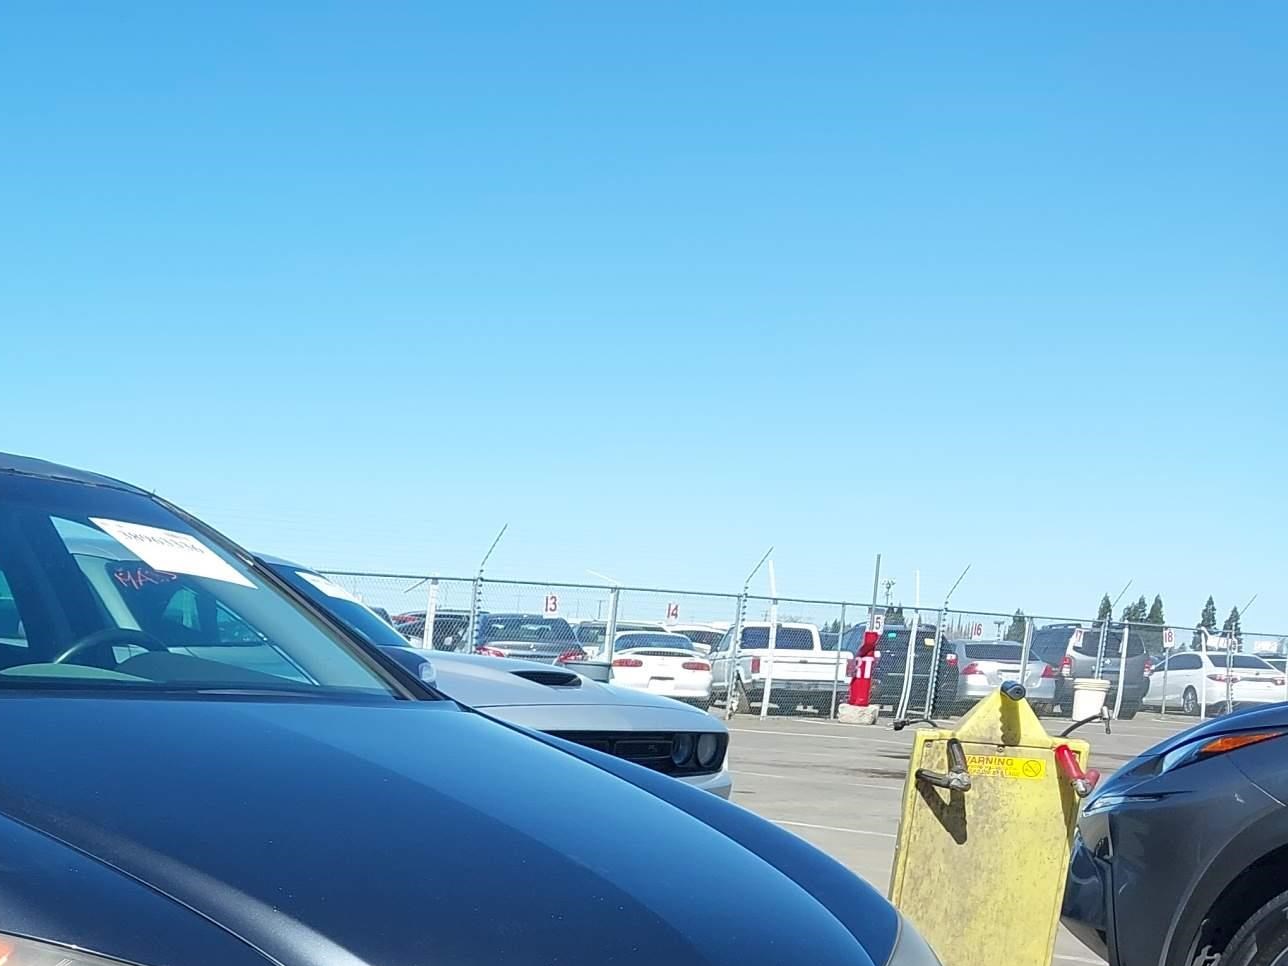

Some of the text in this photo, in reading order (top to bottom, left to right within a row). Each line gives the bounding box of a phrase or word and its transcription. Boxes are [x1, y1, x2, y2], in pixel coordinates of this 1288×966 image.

[544, 595, 558, 612] 13
[666, 603, 679, 619] 14
[973, 623, 982, 636] 16
[1164, 630, 1174, 643] 18
